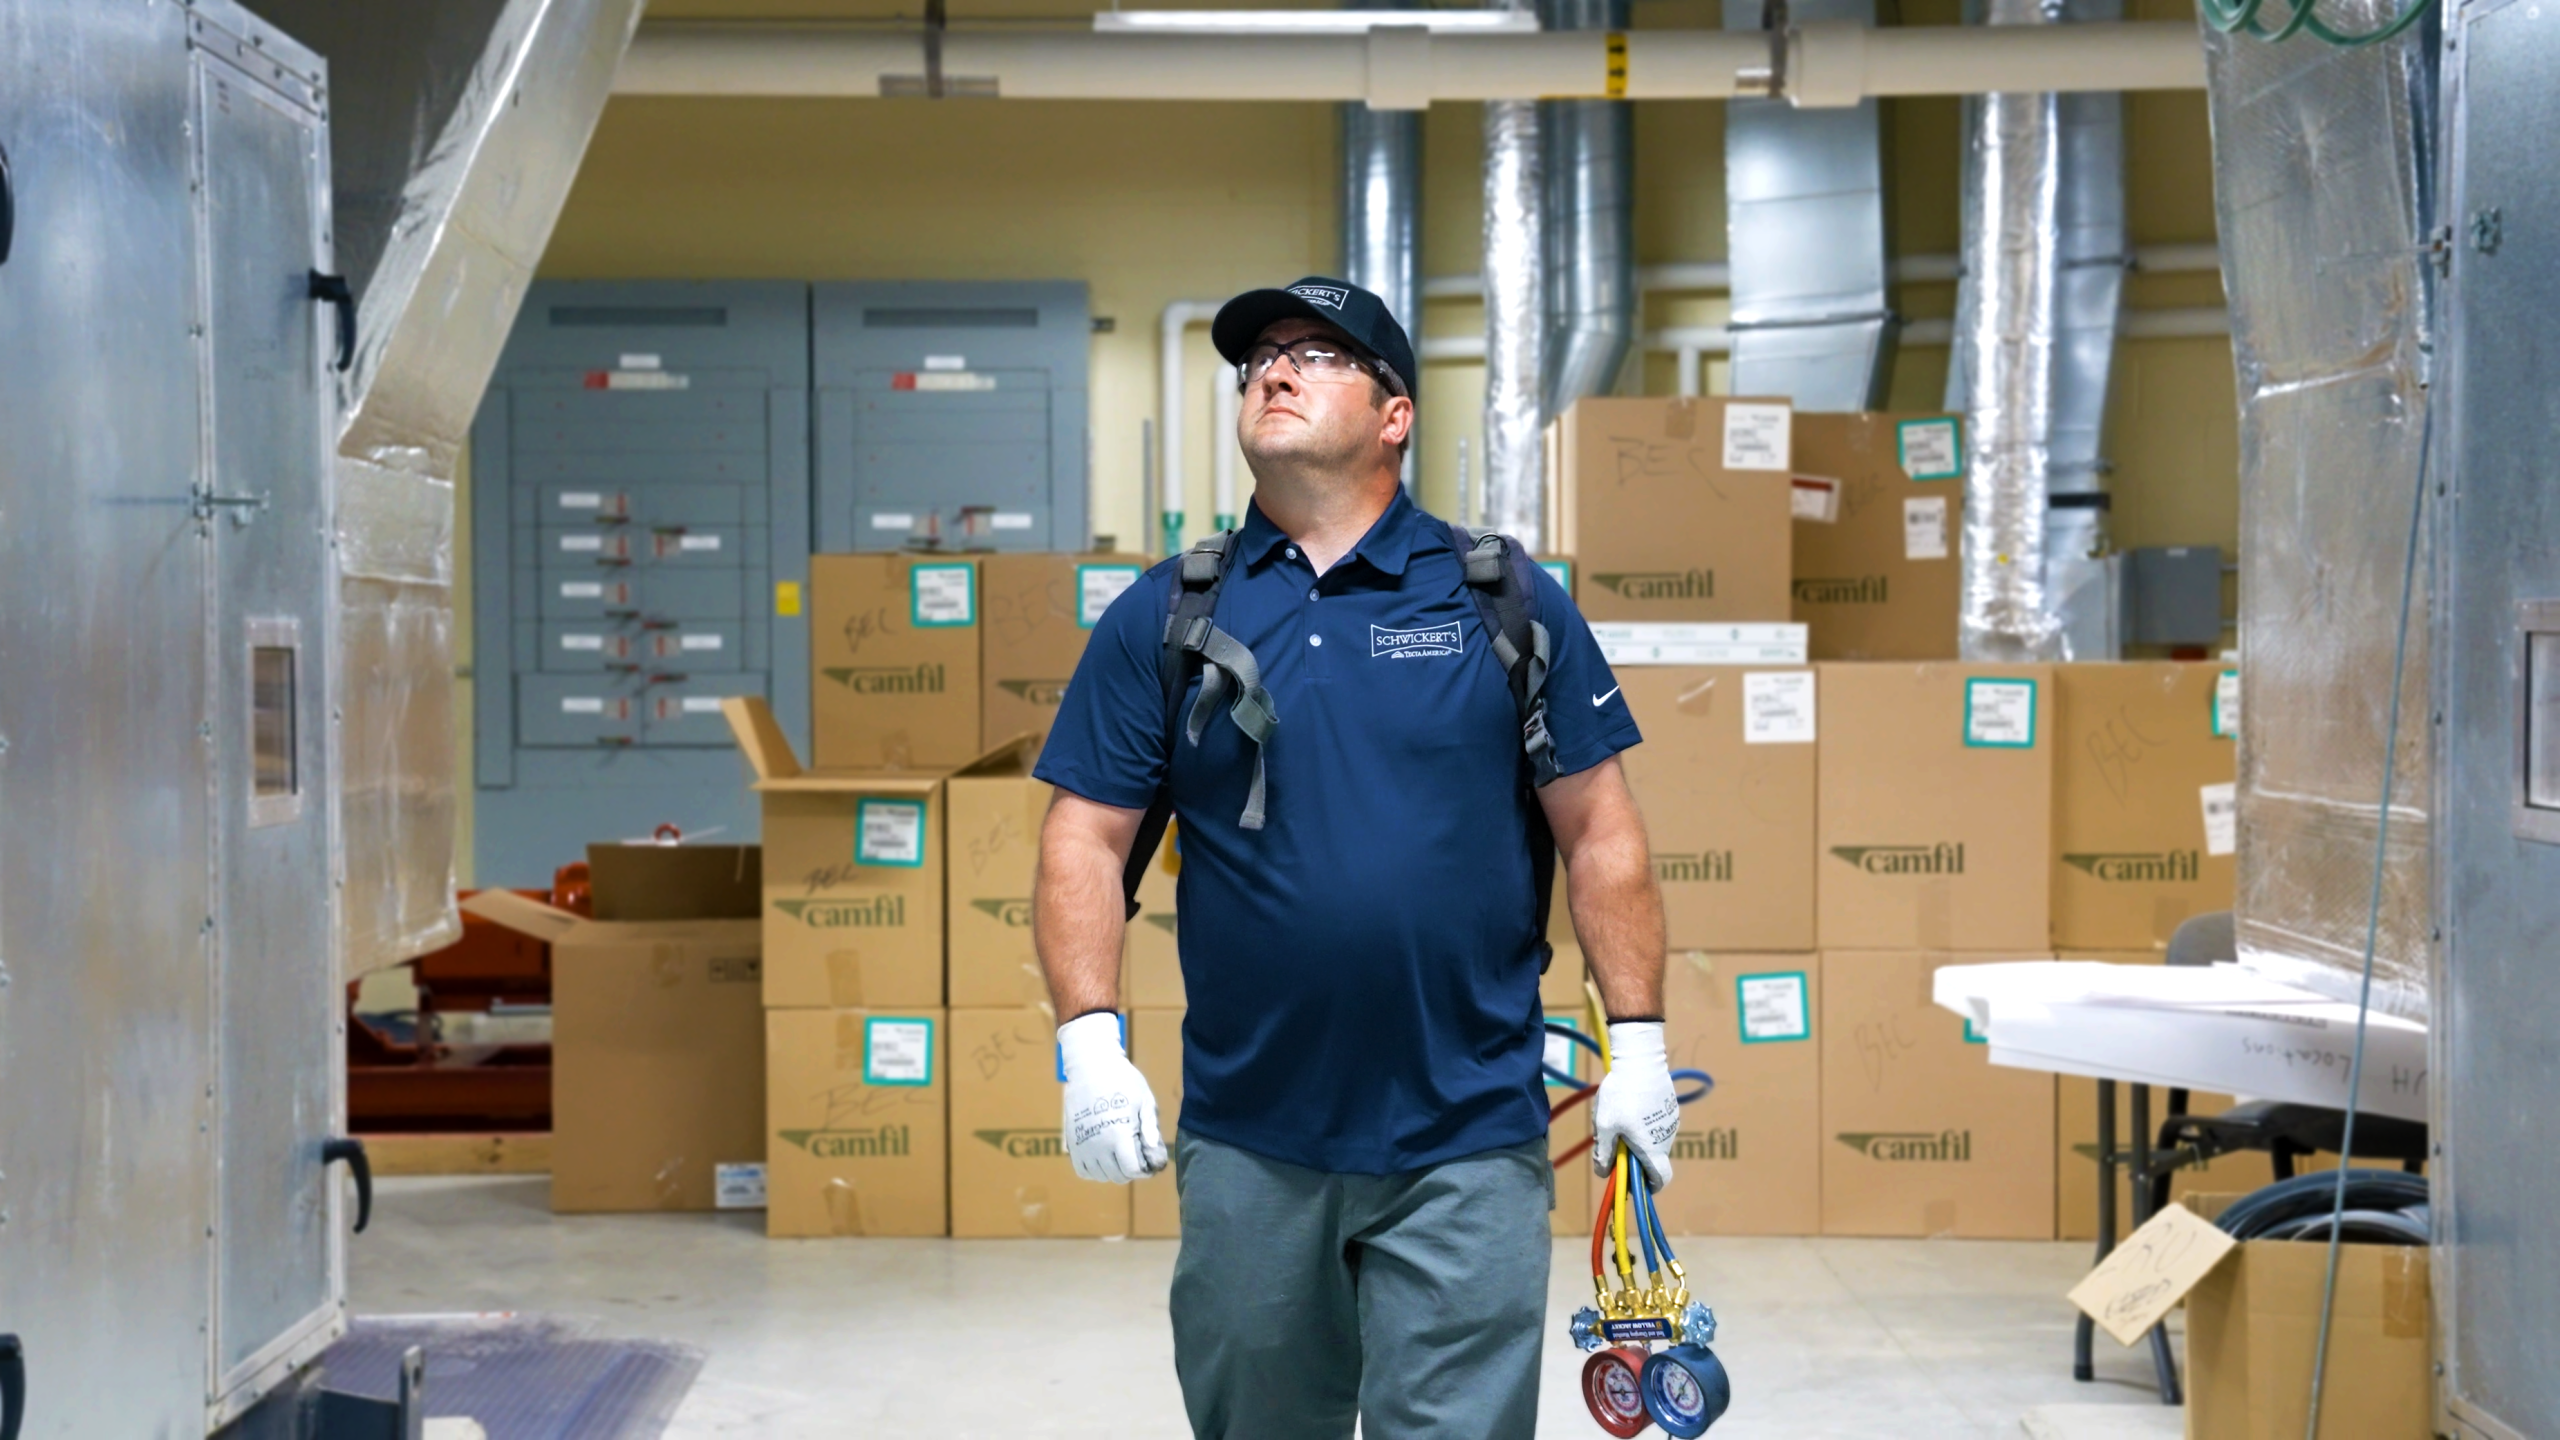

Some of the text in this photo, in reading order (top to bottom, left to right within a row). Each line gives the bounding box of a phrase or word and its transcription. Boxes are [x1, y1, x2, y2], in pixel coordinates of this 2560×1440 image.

[1622, 569, 1714, 600] camfil
[1801, 576, 1888, 604] camfil
[1376, 630, 1458, 646] SCHWICKERT'S
[854, 663, 946, 694] camfil
[1652, 848, 1732, 882] amfil
[1865, 842, 1965, 875] camfil
[2098, 850, 2199, 882] camfil
[806, 895, 906, 929] camfil
[812, 1124, 911, 1158] camfil
[1871, 1128, 1971, 1161] camfil
